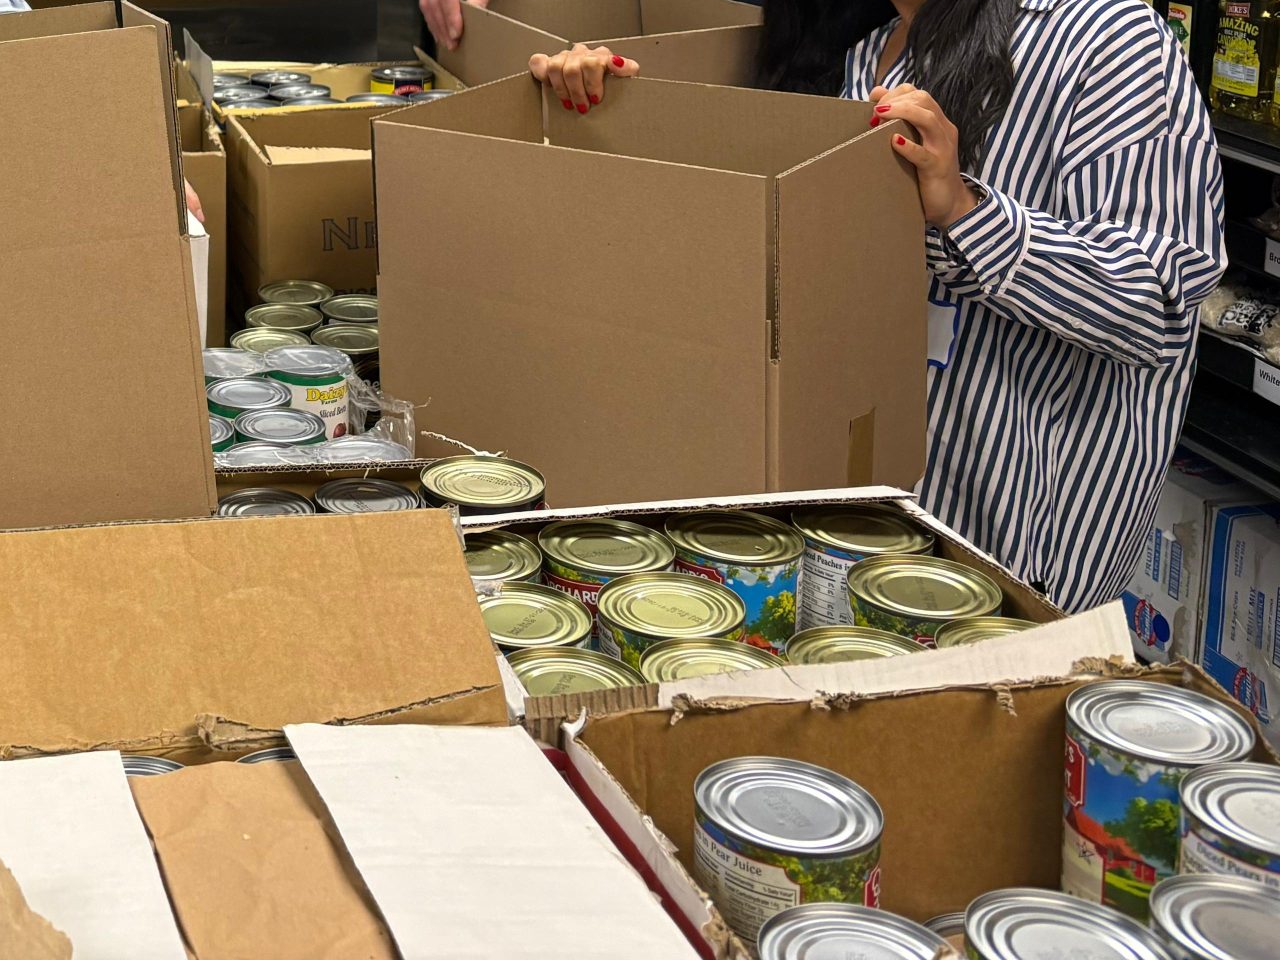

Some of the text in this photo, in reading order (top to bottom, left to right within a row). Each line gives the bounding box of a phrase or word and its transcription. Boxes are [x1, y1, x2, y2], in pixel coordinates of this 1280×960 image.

[1228, 4, 1248, 15] MIKE'S
[1219, 17, 1259, 36] AMAZING
[319, 407, 336, 418] Sliced
[817, 555, 843, 569] Peaches
[1248, 586, 1256, 607] MIX
[710, 841, 731, 863] Pear
[733, 854, 763, 877] Juice
